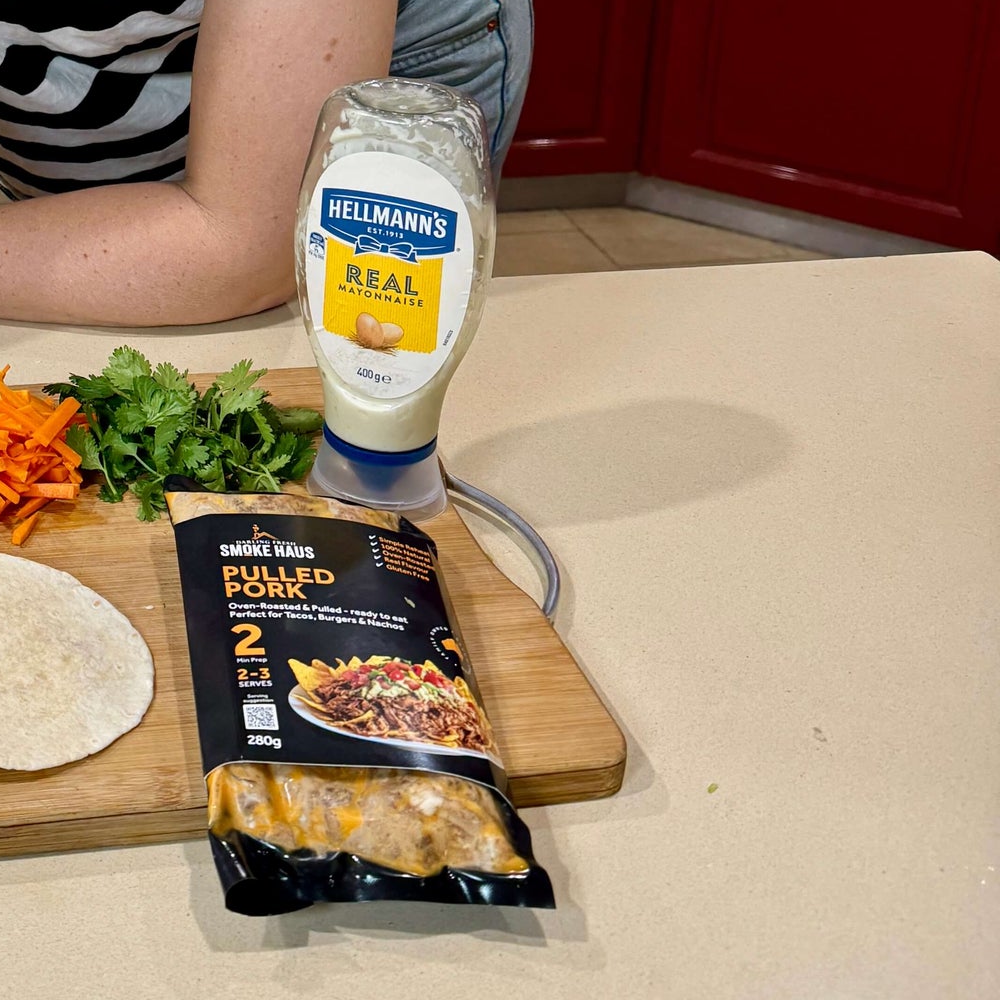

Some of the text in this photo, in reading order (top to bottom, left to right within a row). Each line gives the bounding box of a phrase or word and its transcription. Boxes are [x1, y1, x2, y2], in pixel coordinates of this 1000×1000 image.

[328, 199, 448, 239] HELLMANN'S
[346, 263, 419, 296] REAL
[338, 283, 424, 308] MAYONNAISE
[219, 543, 316, 560] SMOKE HAUS
[222, 565, 336, 585] PULLED
[224, 581, 308, 600] PORK
[228, 602, 301, 611] Oven-Roasted
[302, 604, 311, 612] &
[311, 604, 342, 614] Pulled
[350, 608, 378, 620] ready
[379, 612, 391, 621] to
[392, 615, 409, 625] eat
[229, 611, 405, 631] Perfect for Tacos, Burgers & Nachos
[230, 623, 266, 656] 2
[238, 680, 273, 688] SERVES
[246, 734, 282, 749] 280g
